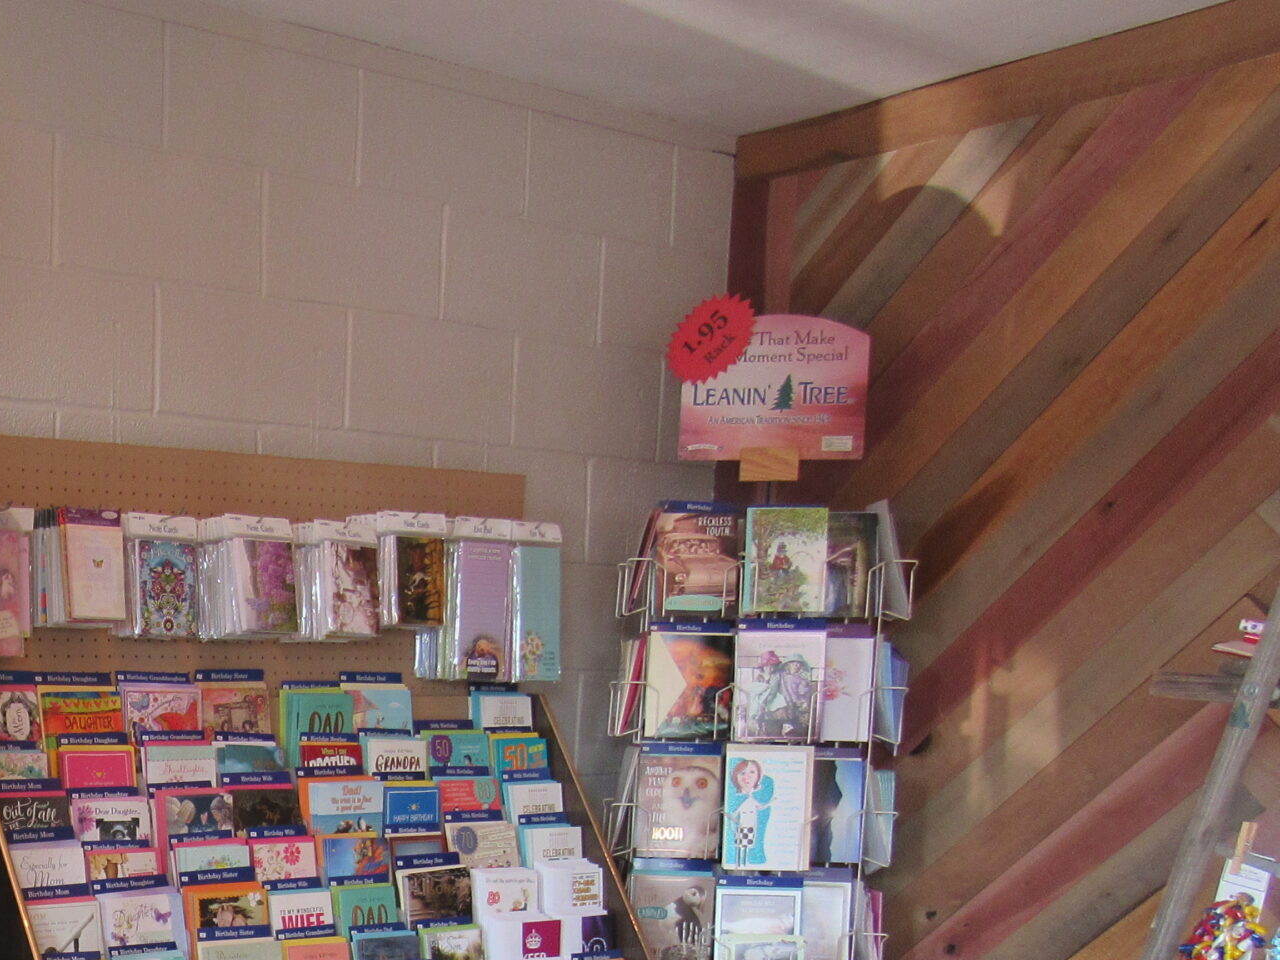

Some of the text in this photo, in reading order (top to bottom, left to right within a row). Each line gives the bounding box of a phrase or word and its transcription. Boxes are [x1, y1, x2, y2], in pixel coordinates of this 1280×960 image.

[682, 310, 729, 355] 1.95
[756, 330, 835, 347] That Make
[703, 333, 736, 364] Rack
[796, 345, 849, 364] Special
[693, 382, 848, 406] LEANIN' TREE
[721, 415, 755, 425] AMERICAN
[756, 415, 791, 425] TRADITION
[698, 516, 732, 527] RECKLESS
[64, 716, 114, 729] DAUGHTER
[435, 738, 449, 757] 50
[376, 754, 420, 771] GRANDPA
[504, 744, 528, 771] 50
[3, 798, 24, 820] Out
[95, 807, 109, 815] Dear
[652, 826, 684, 841] HOOT!
[20, 856, 67, 872] Especially for
[28, 871, 64, 887] Mom
[106, 879, 154, 889] Birthday Daughter
[197, 873, 221, 881] Birthday
[28, 890, 53, 898] Birthday
[296, 907, 324, 915] WONDERFUL
